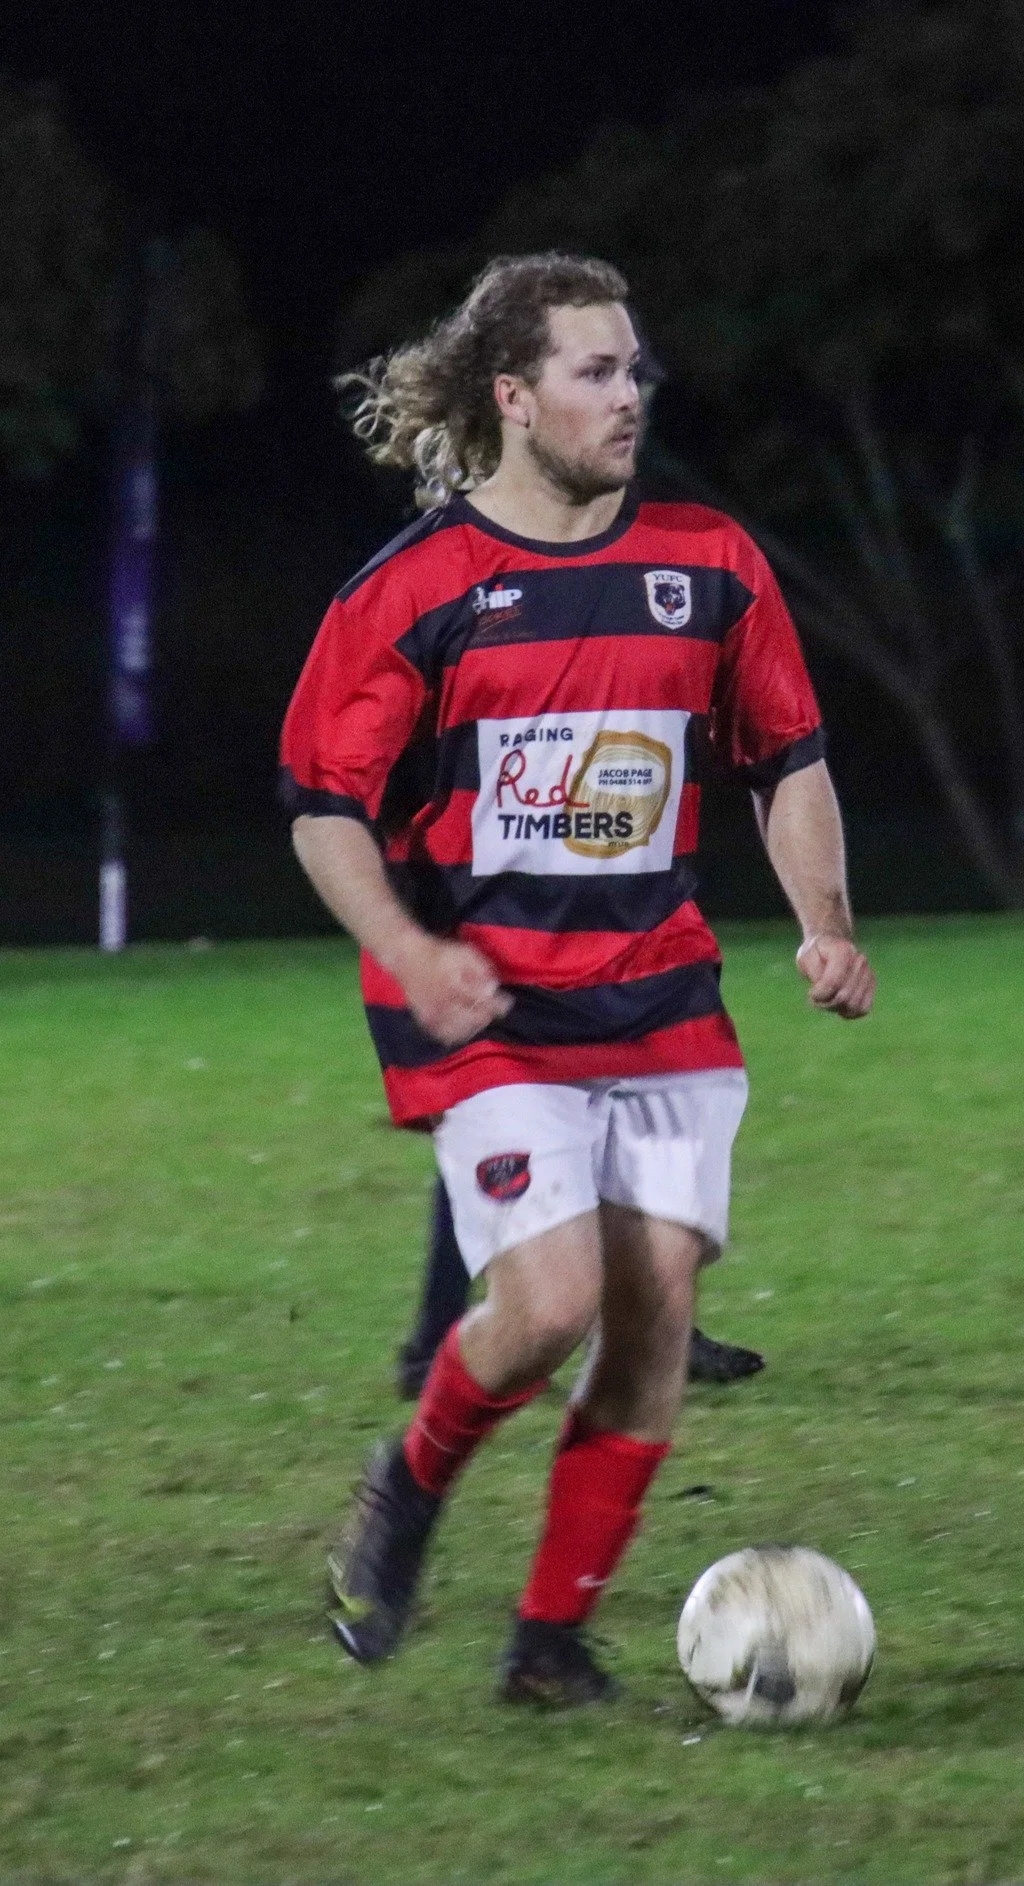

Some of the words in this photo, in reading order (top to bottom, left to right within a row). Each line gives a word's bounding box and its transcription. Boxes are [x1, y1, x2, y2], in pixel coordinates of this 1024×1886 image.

[500, 727, 574, 747] RAGING
[496, 749, 590, 808] Red
[599, 769, 629, 778] JACOB
[631, 768, 652, 777] PAGE
[498, 811, 633, 840] TIMBERS
